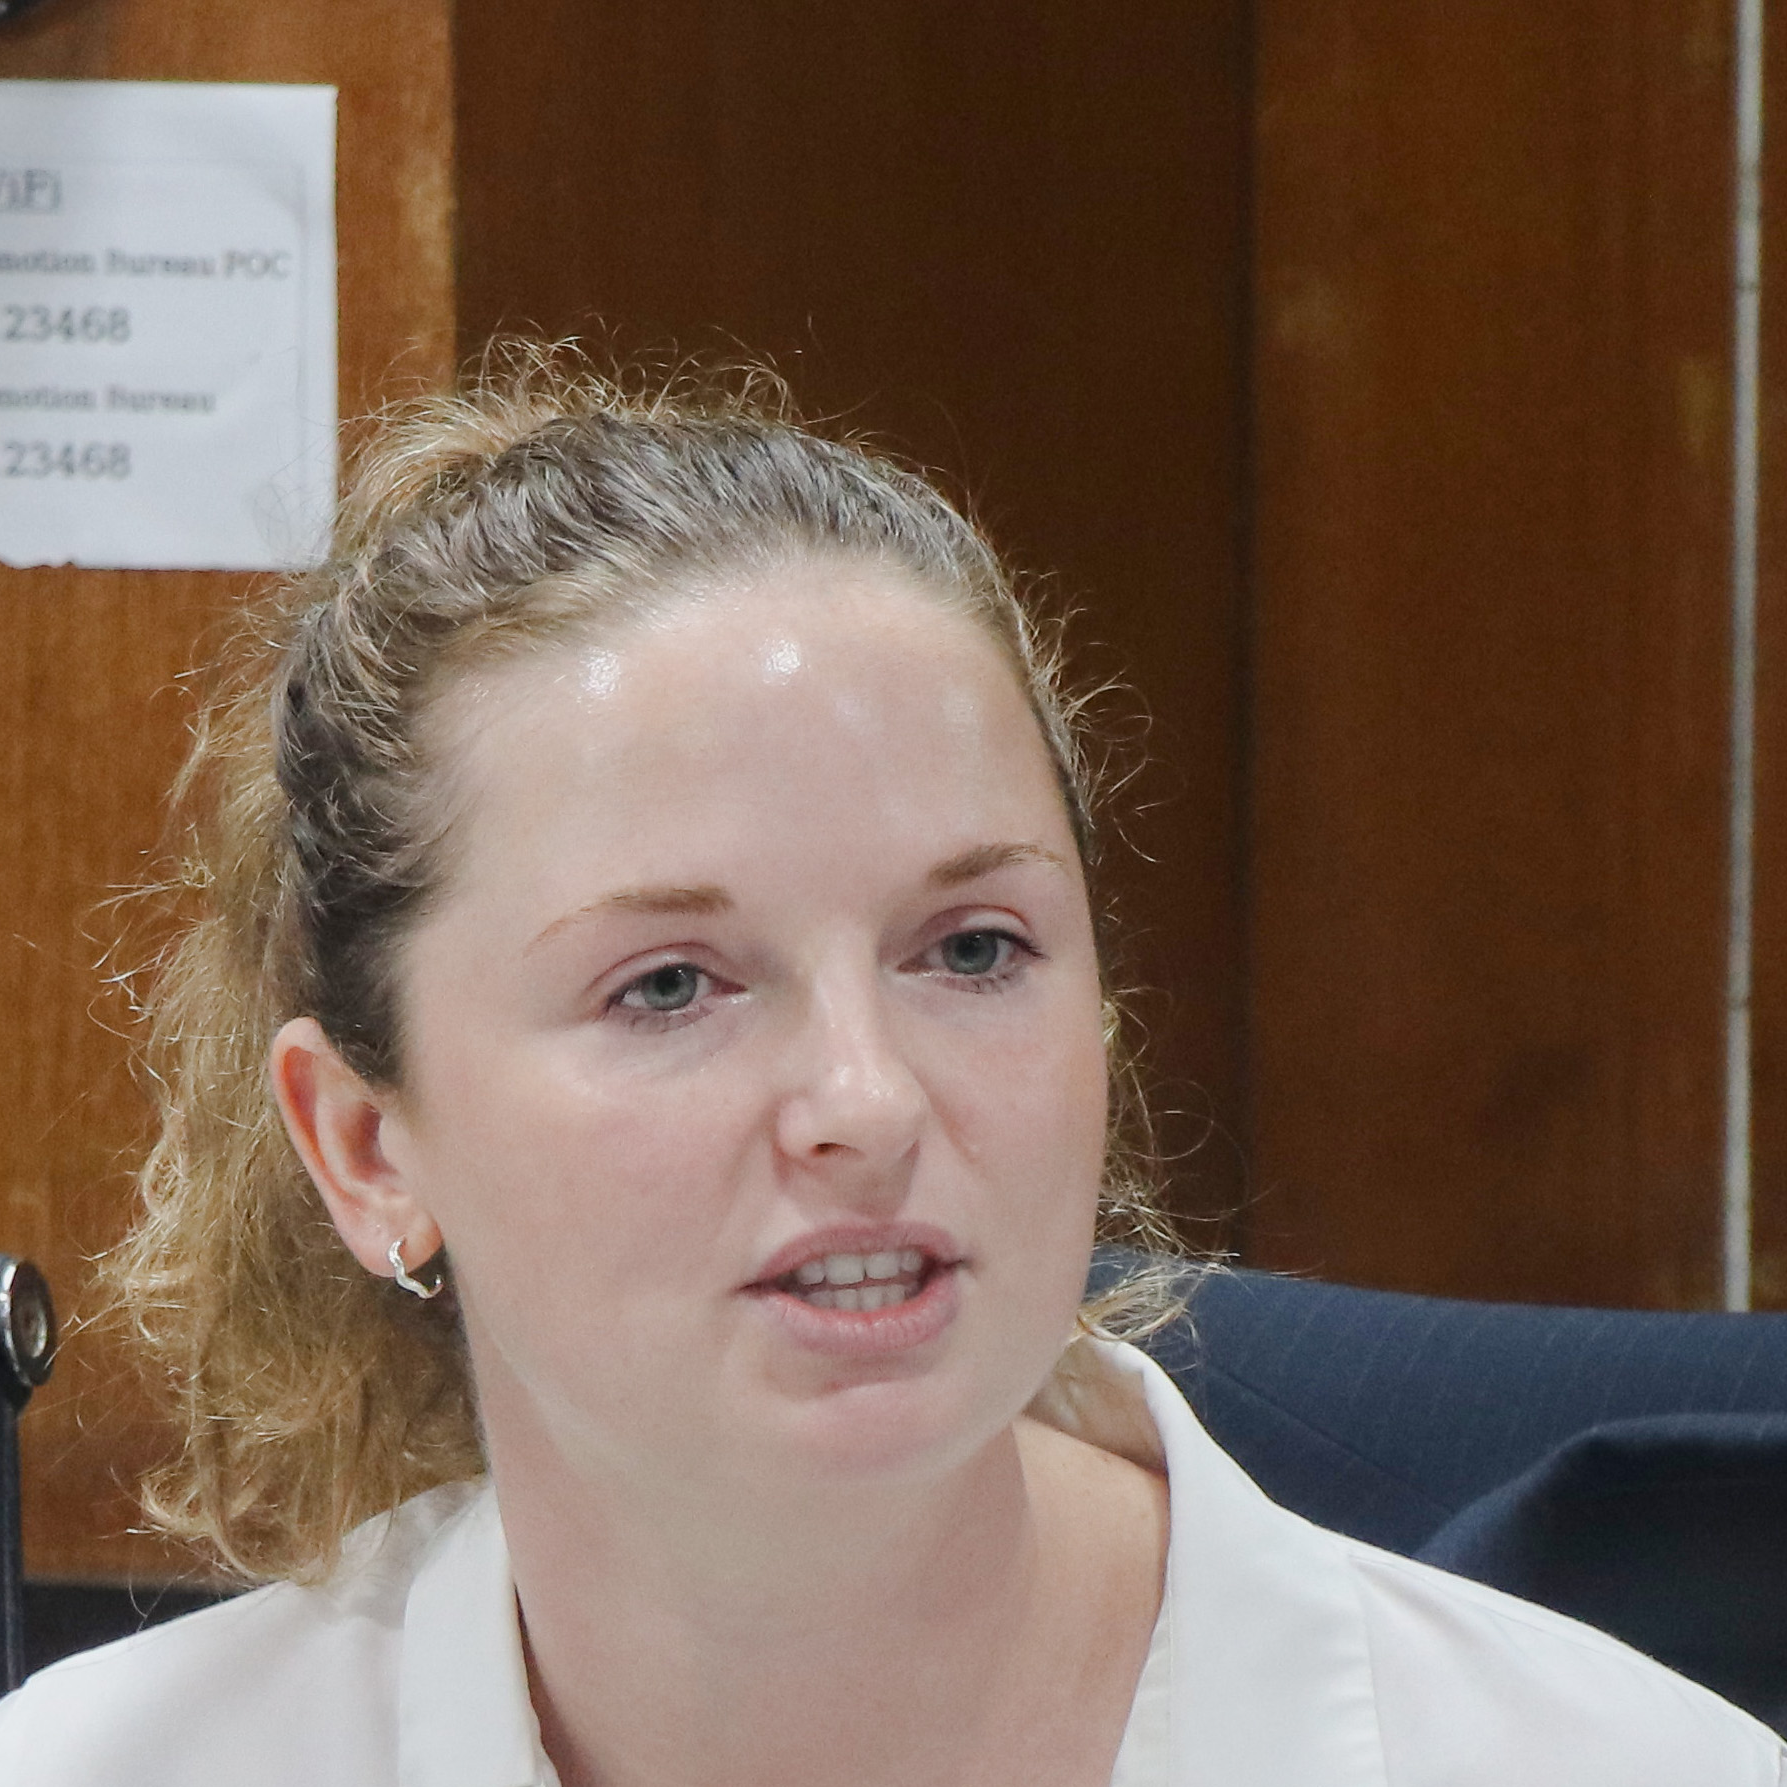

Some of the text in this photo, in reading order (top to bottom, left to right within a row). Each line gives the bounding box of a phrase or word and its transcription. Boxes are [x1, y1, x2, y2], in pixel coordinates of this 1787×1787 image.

[105, 248, 216, 279] Bureau
[223, 250, 291, 280] POC
[106, 384, 217, 415] Bureau
